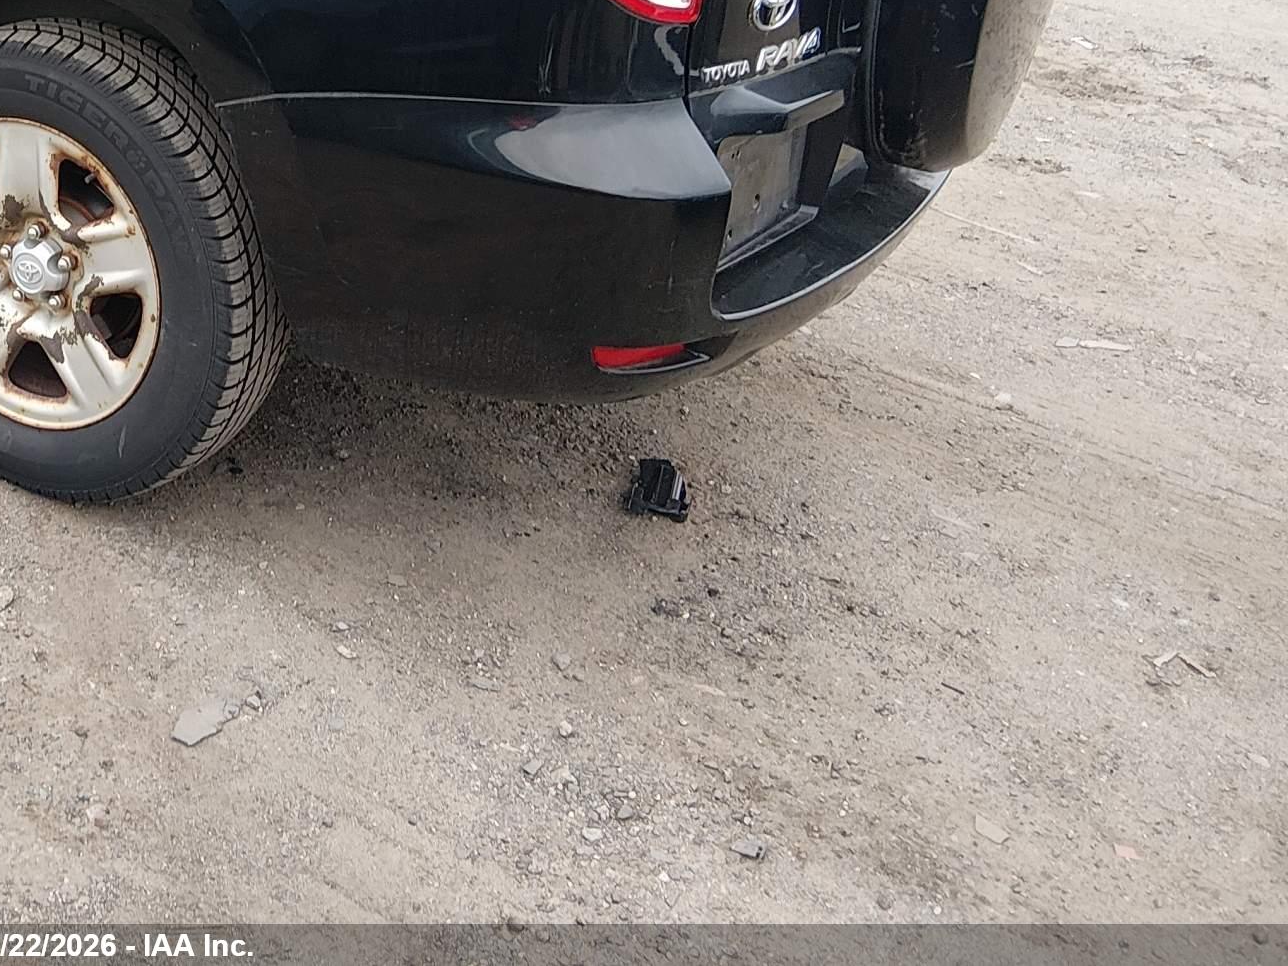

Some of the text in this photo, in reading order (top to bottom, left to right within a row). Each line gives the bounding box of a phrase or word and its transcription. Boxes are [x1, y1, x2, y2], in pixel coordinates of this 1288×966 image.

[701, 26, 823, 85] TOYOTA RAV4
[24, 73, 131, 151] TIGER
